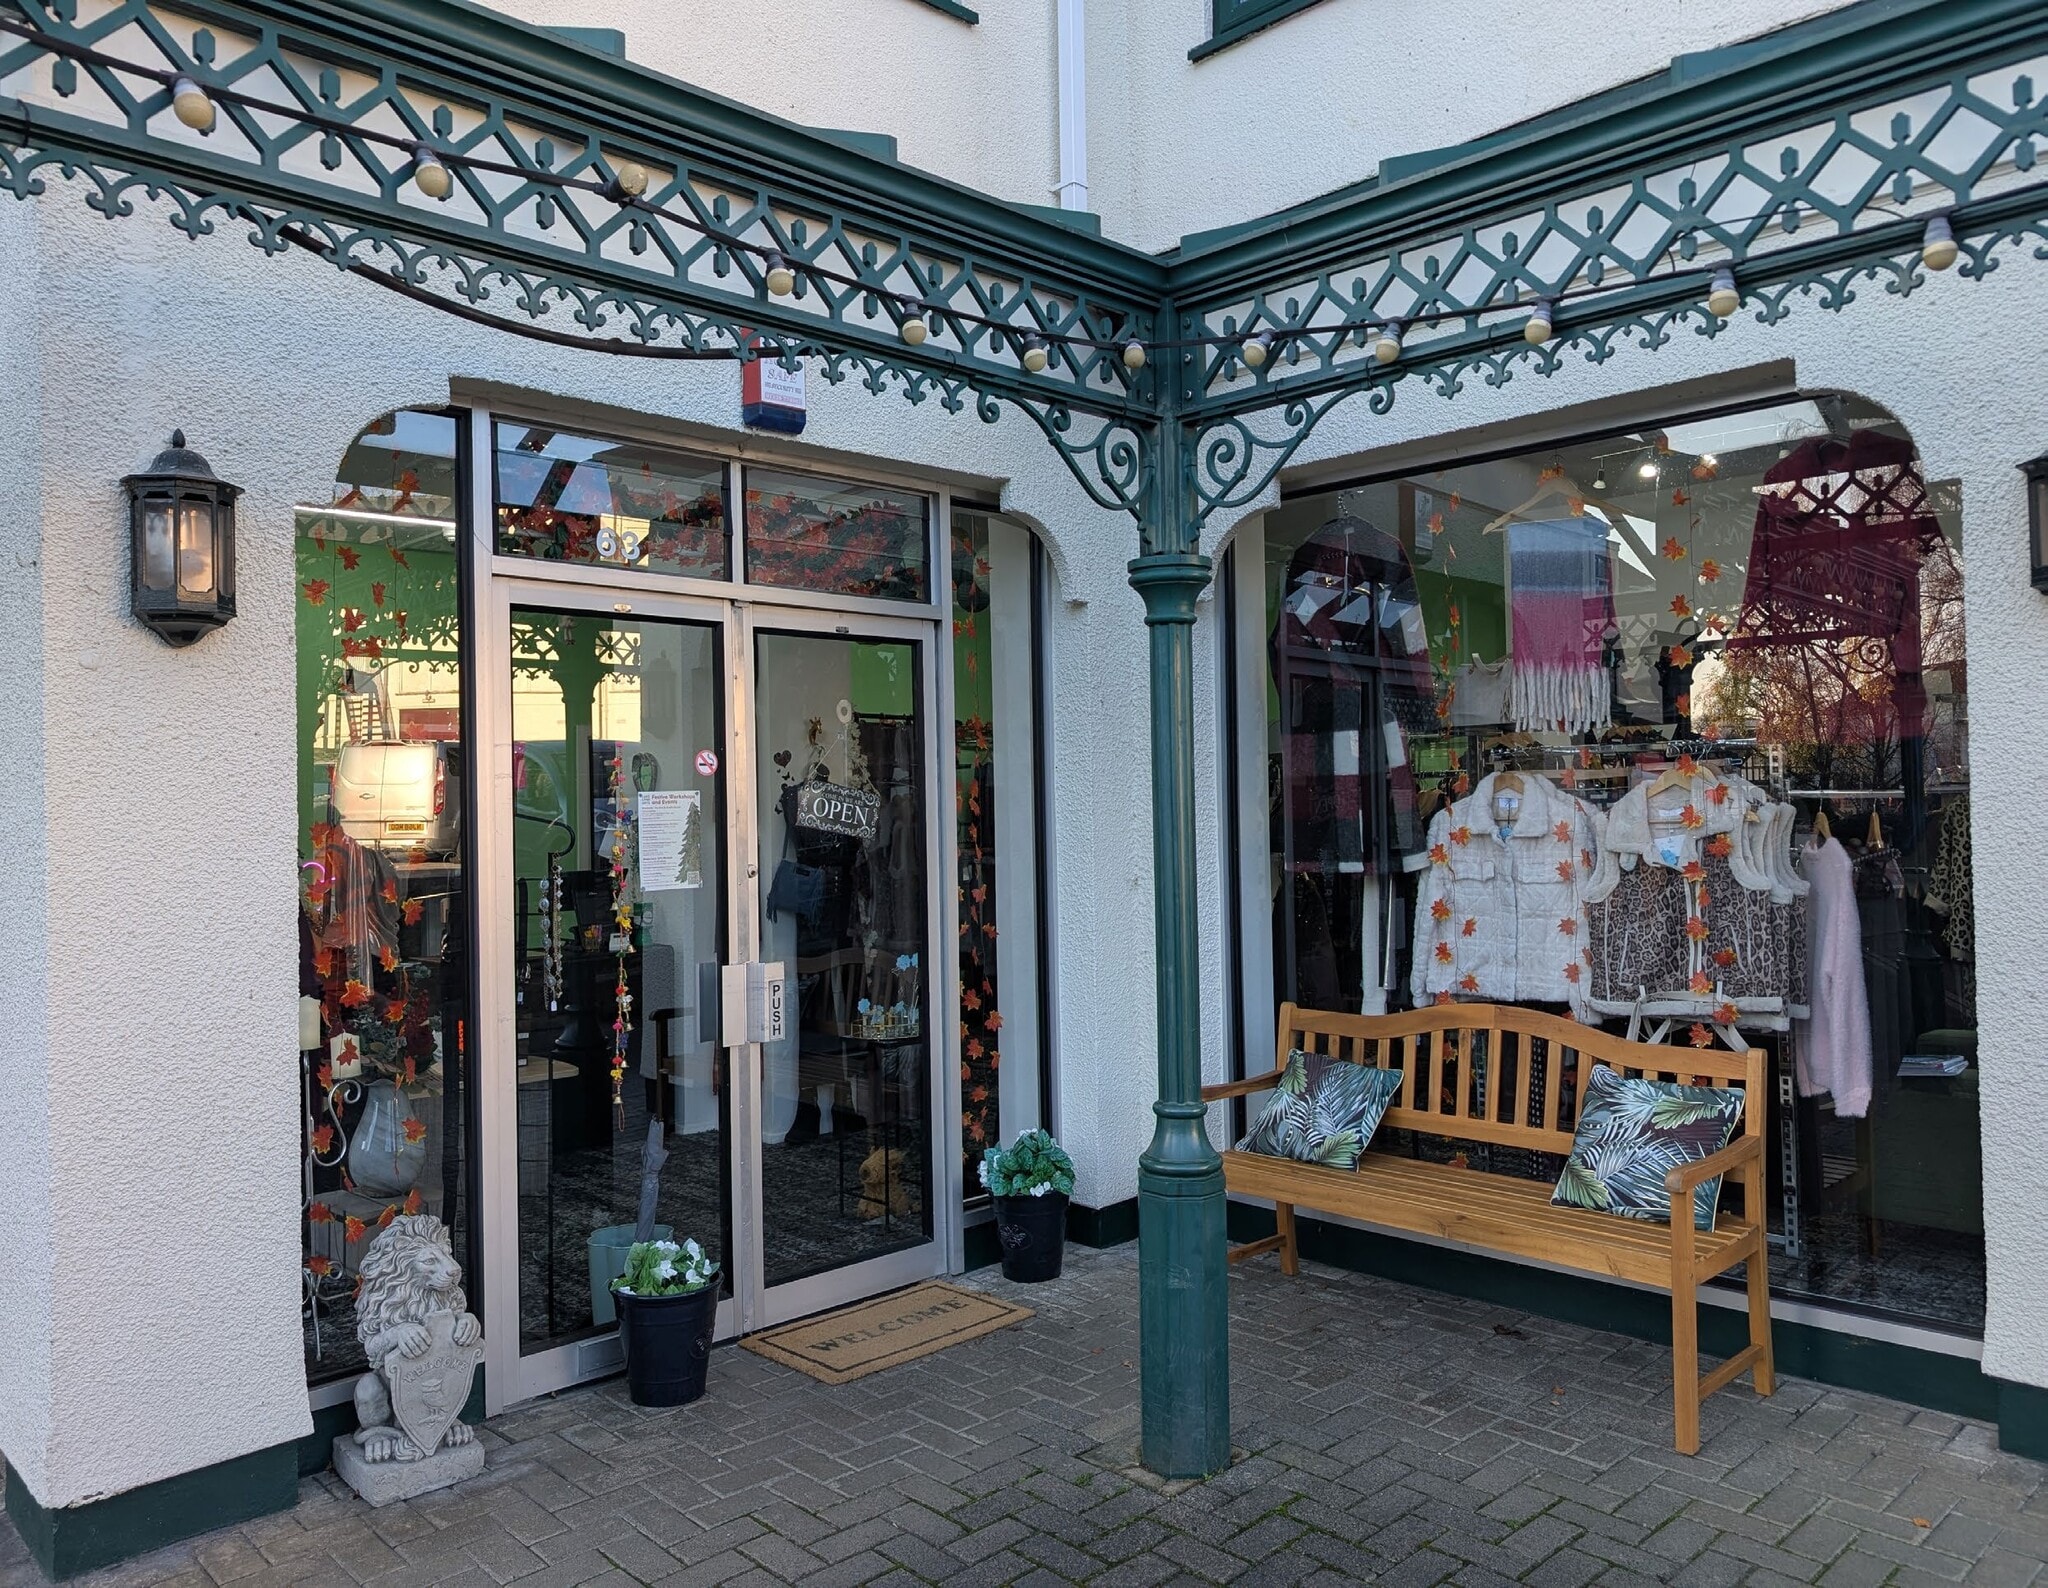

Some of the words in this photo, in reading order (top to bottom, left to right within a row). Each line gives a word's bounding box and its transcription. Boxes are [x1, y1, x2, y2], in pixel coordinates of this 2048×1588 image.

[767, 368, 798, 384] SAFE
[596, 527, 640, 560] 63
[813, 797, 869, 826] OPEN
[821, 793, 838, 801] COME
[772, 984, 782, 1036] PUSH
[805, 1296, 970, 1352] WELCOME
[402, 1357, 469, 1385] WELCOME
